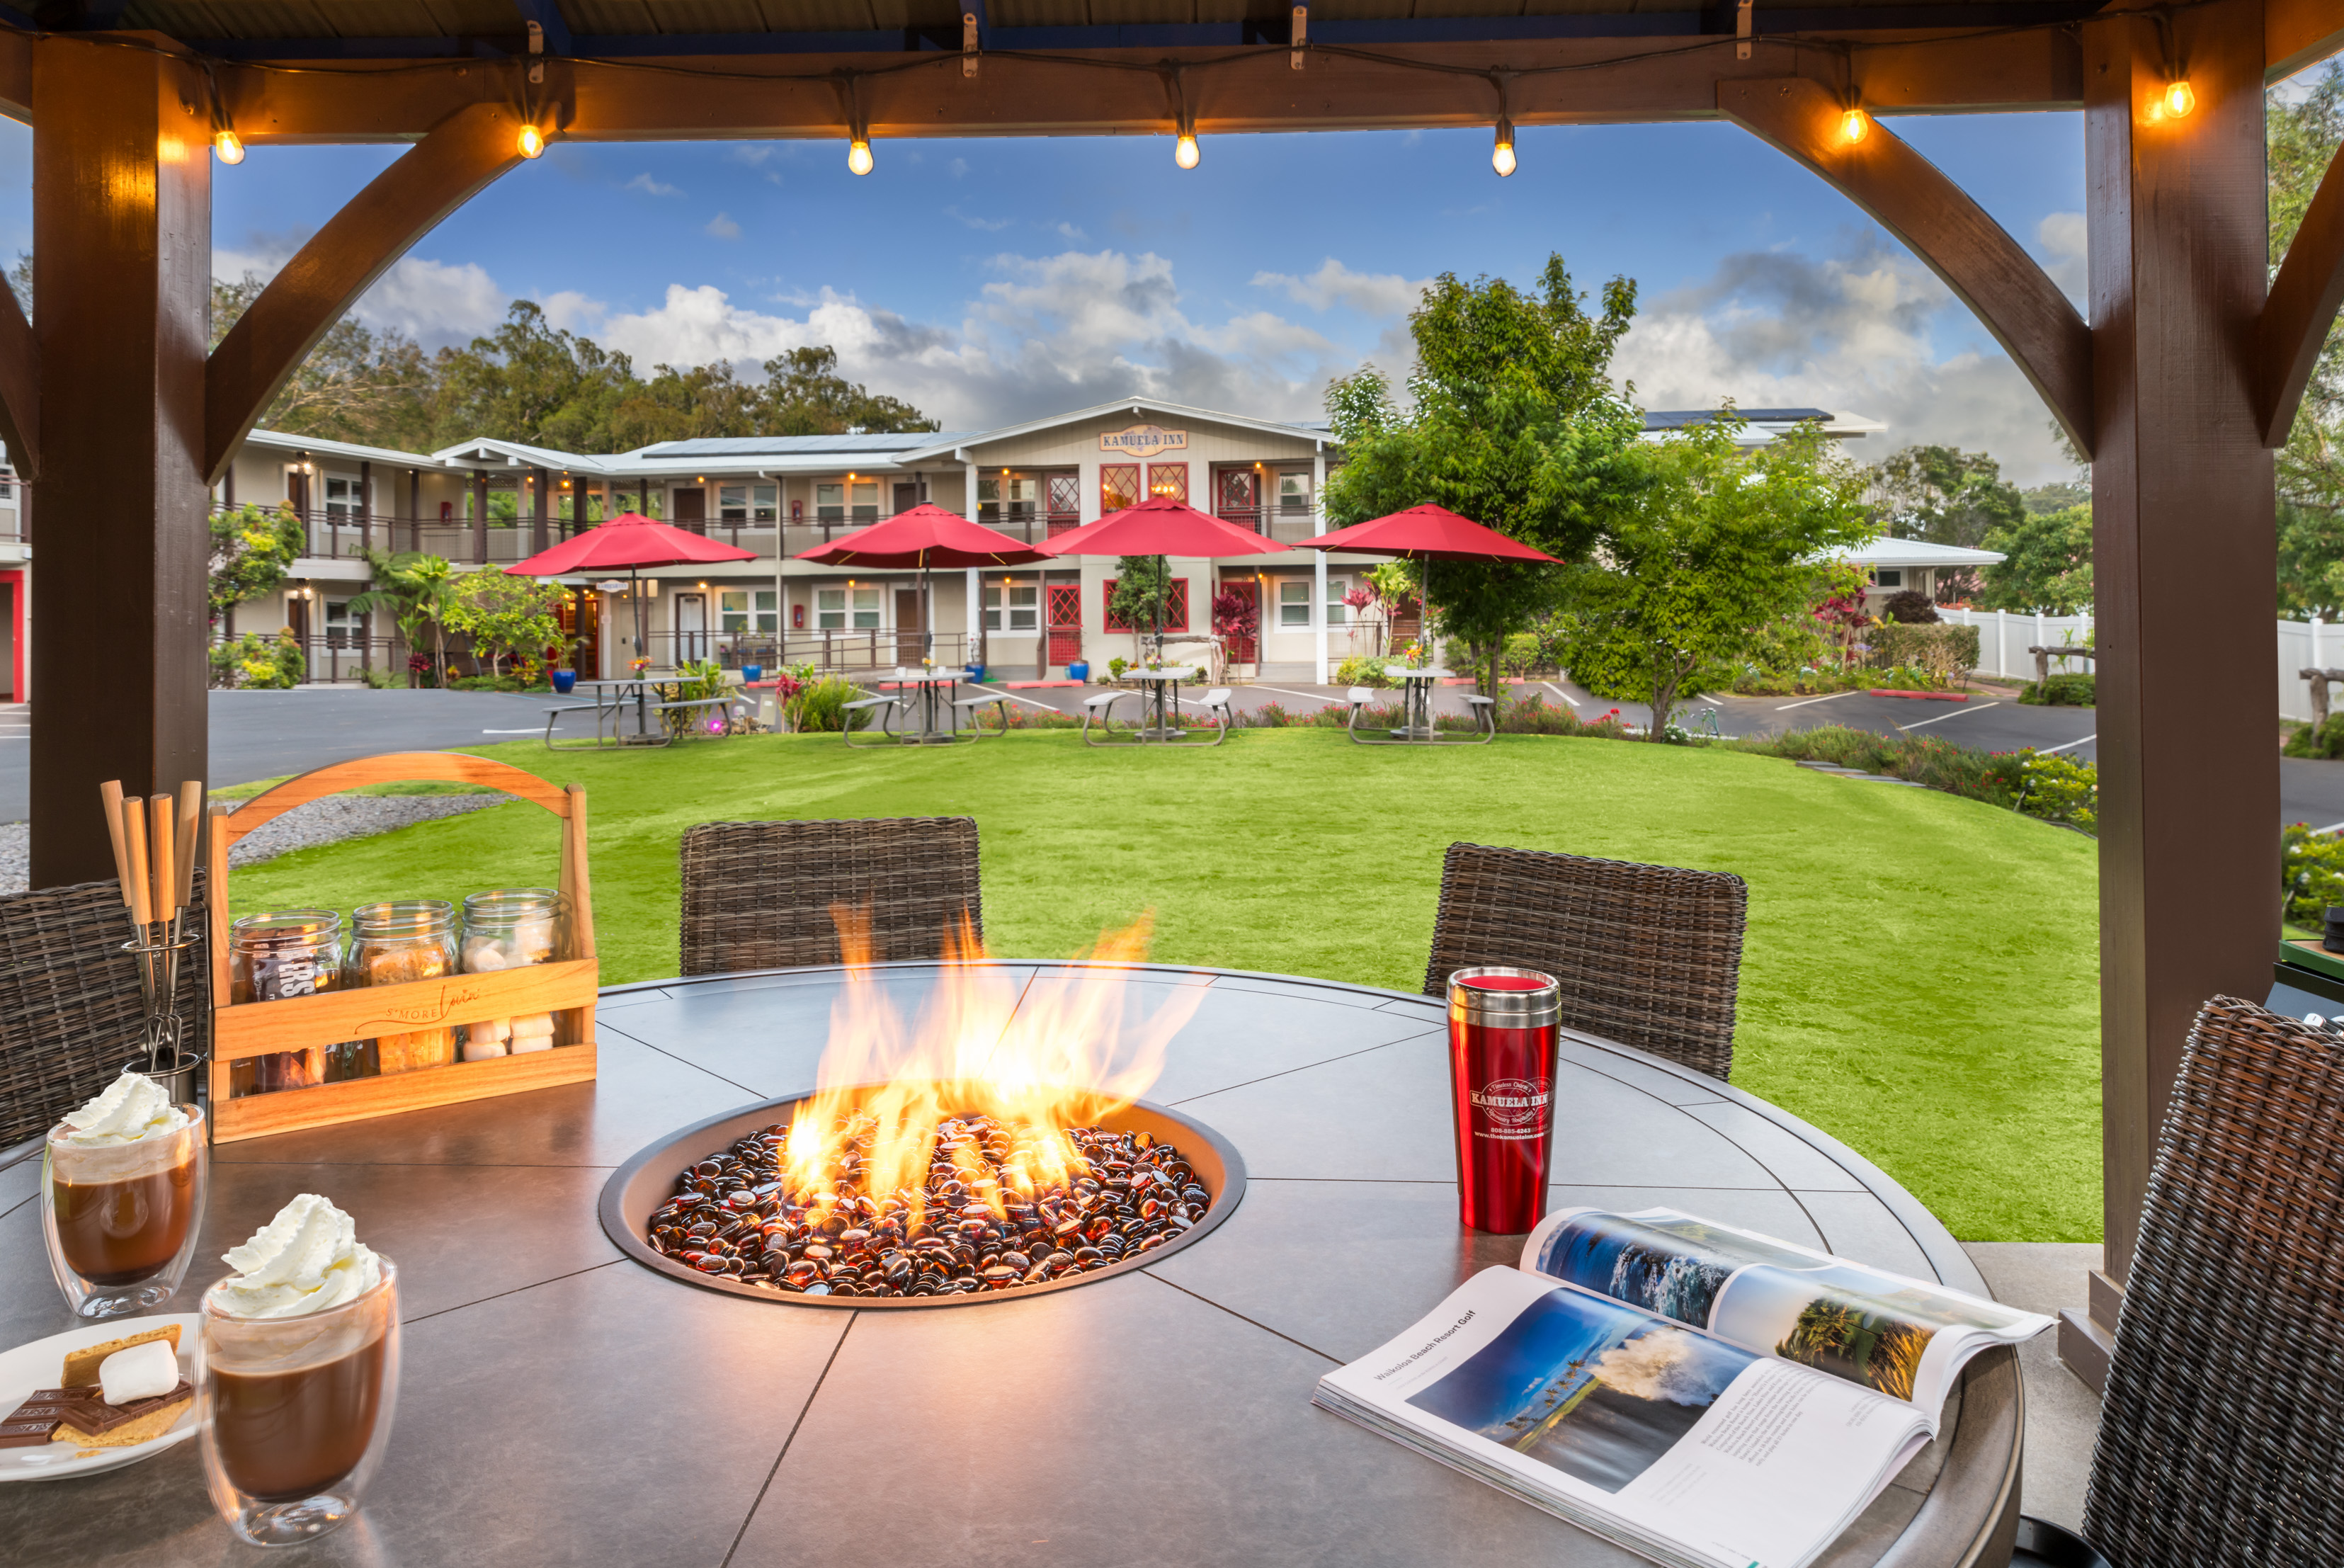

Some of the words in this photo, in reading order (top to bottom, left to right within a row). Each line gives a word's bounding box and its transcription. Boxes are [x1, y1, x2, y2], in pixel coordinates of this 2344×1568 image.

[1103, 435, 1159, 446] KAMUELA
[1163, 434, 1183, 445] INN
[386, 1008, 437, 1020] S'MORE
[1491, 1081, 1512, 1090] Timeless
[1513, 1081, 1529, 1091] Charm
[1471, 1093, 1528, 1107] KAMUELA
[1530, 1093, 1547, 1106] INN
[1488, 1108, 1510, 1124] Upcountry
[1511, 1110, 1534, 1123] Hospitality
[1474, 1131, 1544, 1140] www.thekamuelainn.com
[1373, 1359, 1413, 1380] Waikoloa
[1409, 1343, 1437, 1360] Beach
[1433, 1324, 1462, 1343] Resort
[1457, 1309, 1476, 1325] Golf
[1719, 1422, 1733, 1433] Beach
[1728, 1412, 1741, 1424] Resort
[1734, 1428, 1748, 1440] Beach
[1743, 1419, 1756, 1430] Resort
[1751, 1426, 1760, 1434] that
